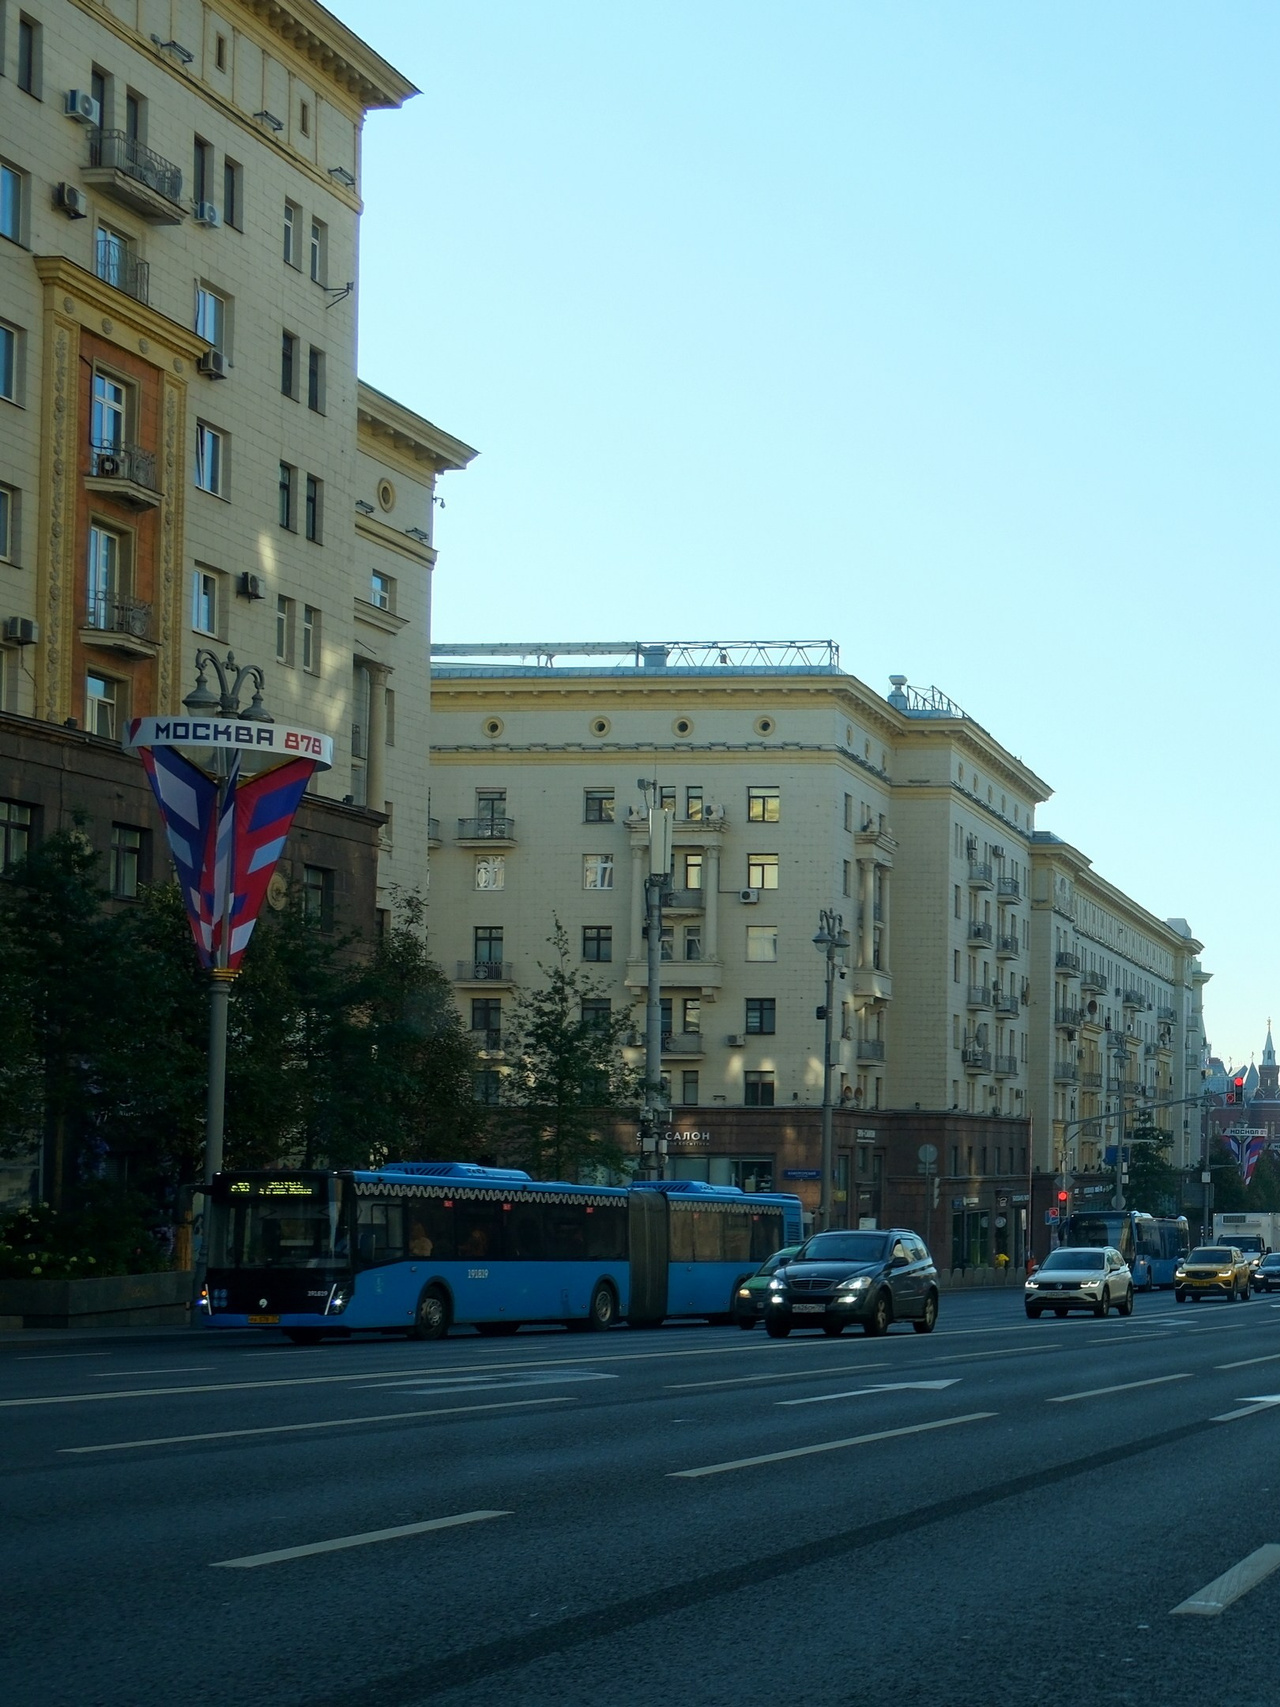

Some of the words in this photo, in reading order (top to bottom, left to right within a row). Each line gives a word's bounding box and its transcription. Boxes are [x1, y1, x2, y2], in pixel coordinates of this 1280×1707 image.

[155, 722, 273, 746] МОСКВА
[285, 732, 322, 755] 878
[665, 1131, 710, 1141] САЛОН
